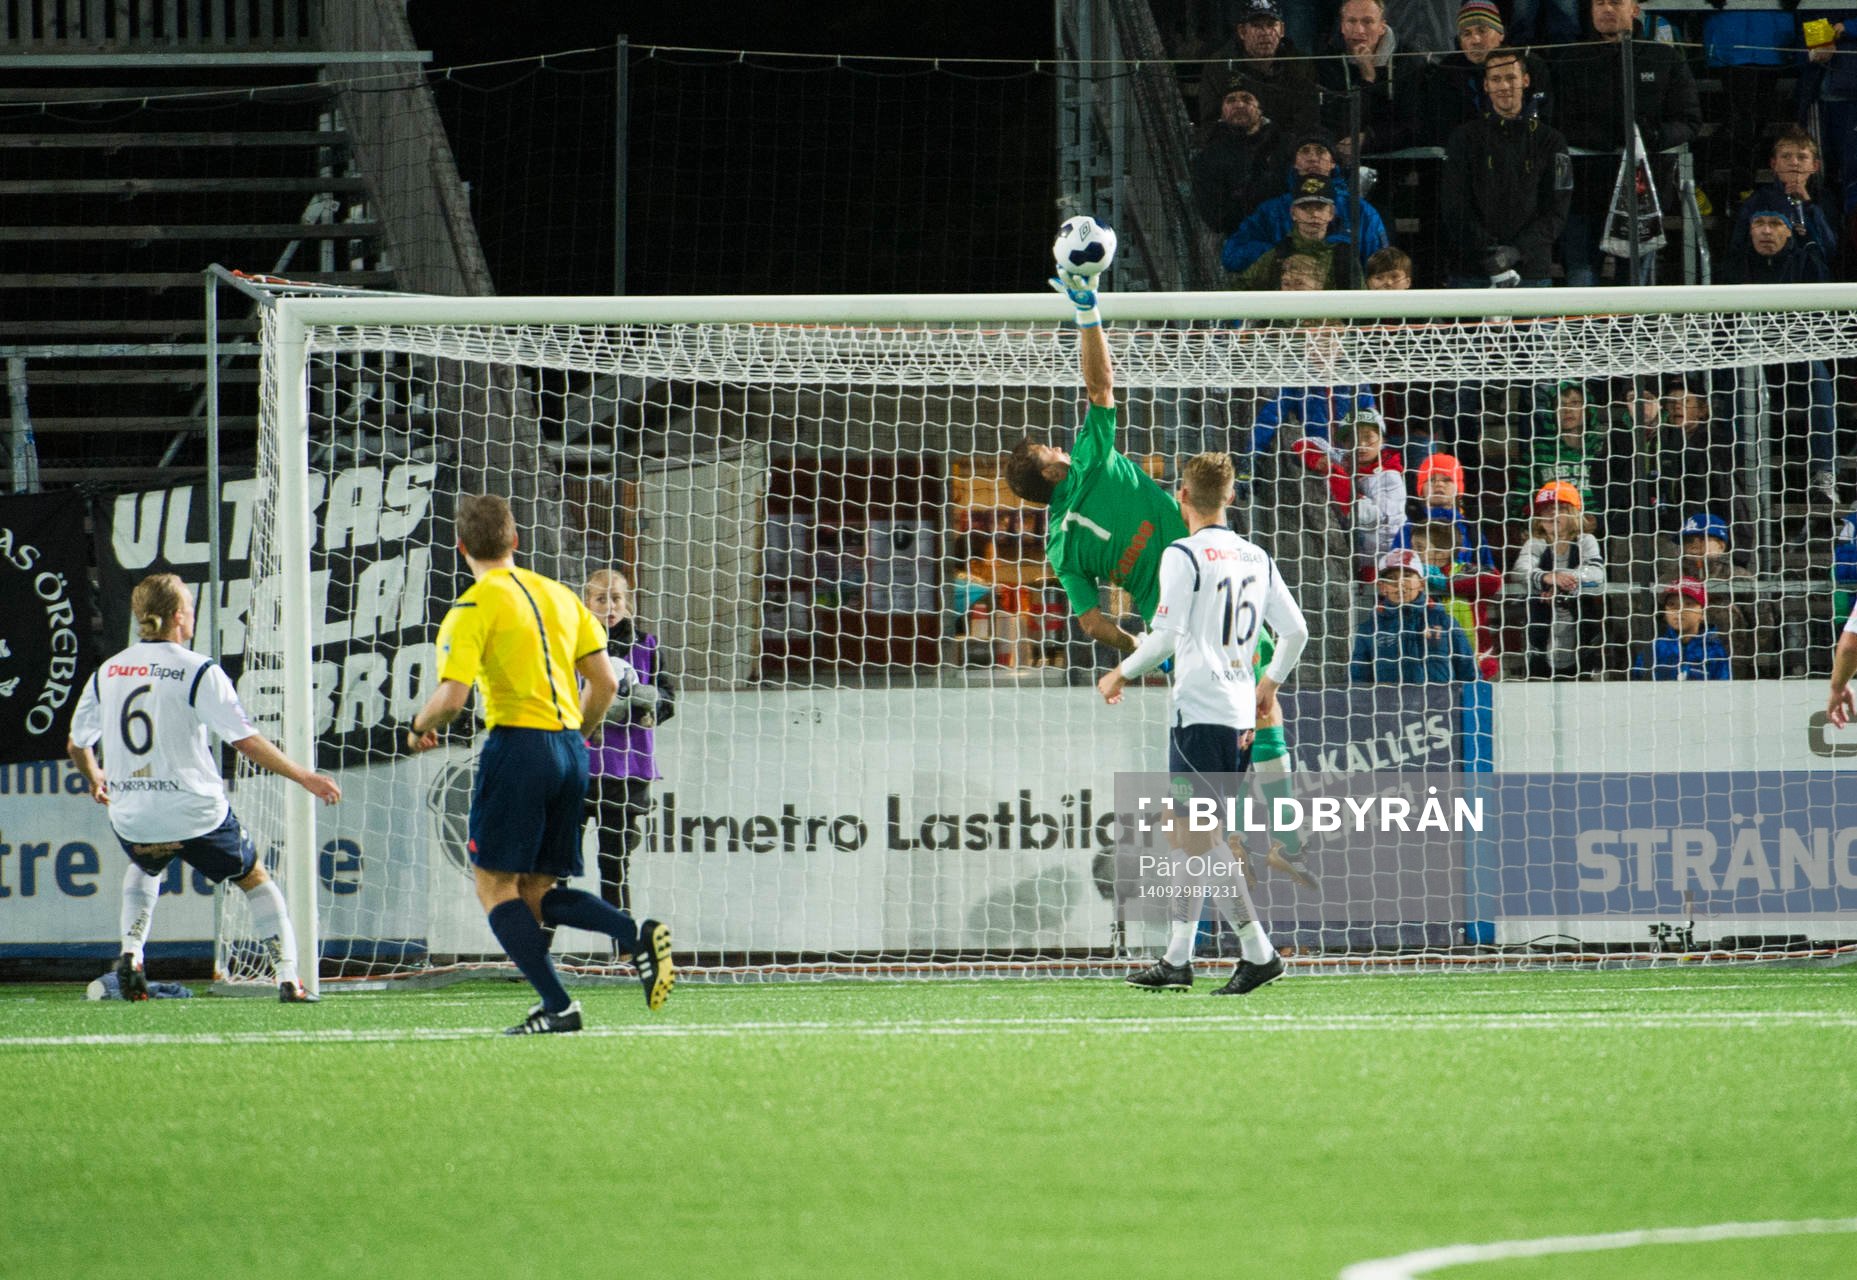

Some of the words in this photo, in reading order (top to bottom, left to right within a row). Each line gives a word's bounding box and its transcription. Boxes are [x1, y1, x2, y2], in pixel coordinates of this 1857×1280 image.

[1217, 576, 1257, 647] 16
[120, 683, 154, 756] 6
[1292, 714, 1451, 797] LKALLES
[630, 792, 868, 853] ilmetro
